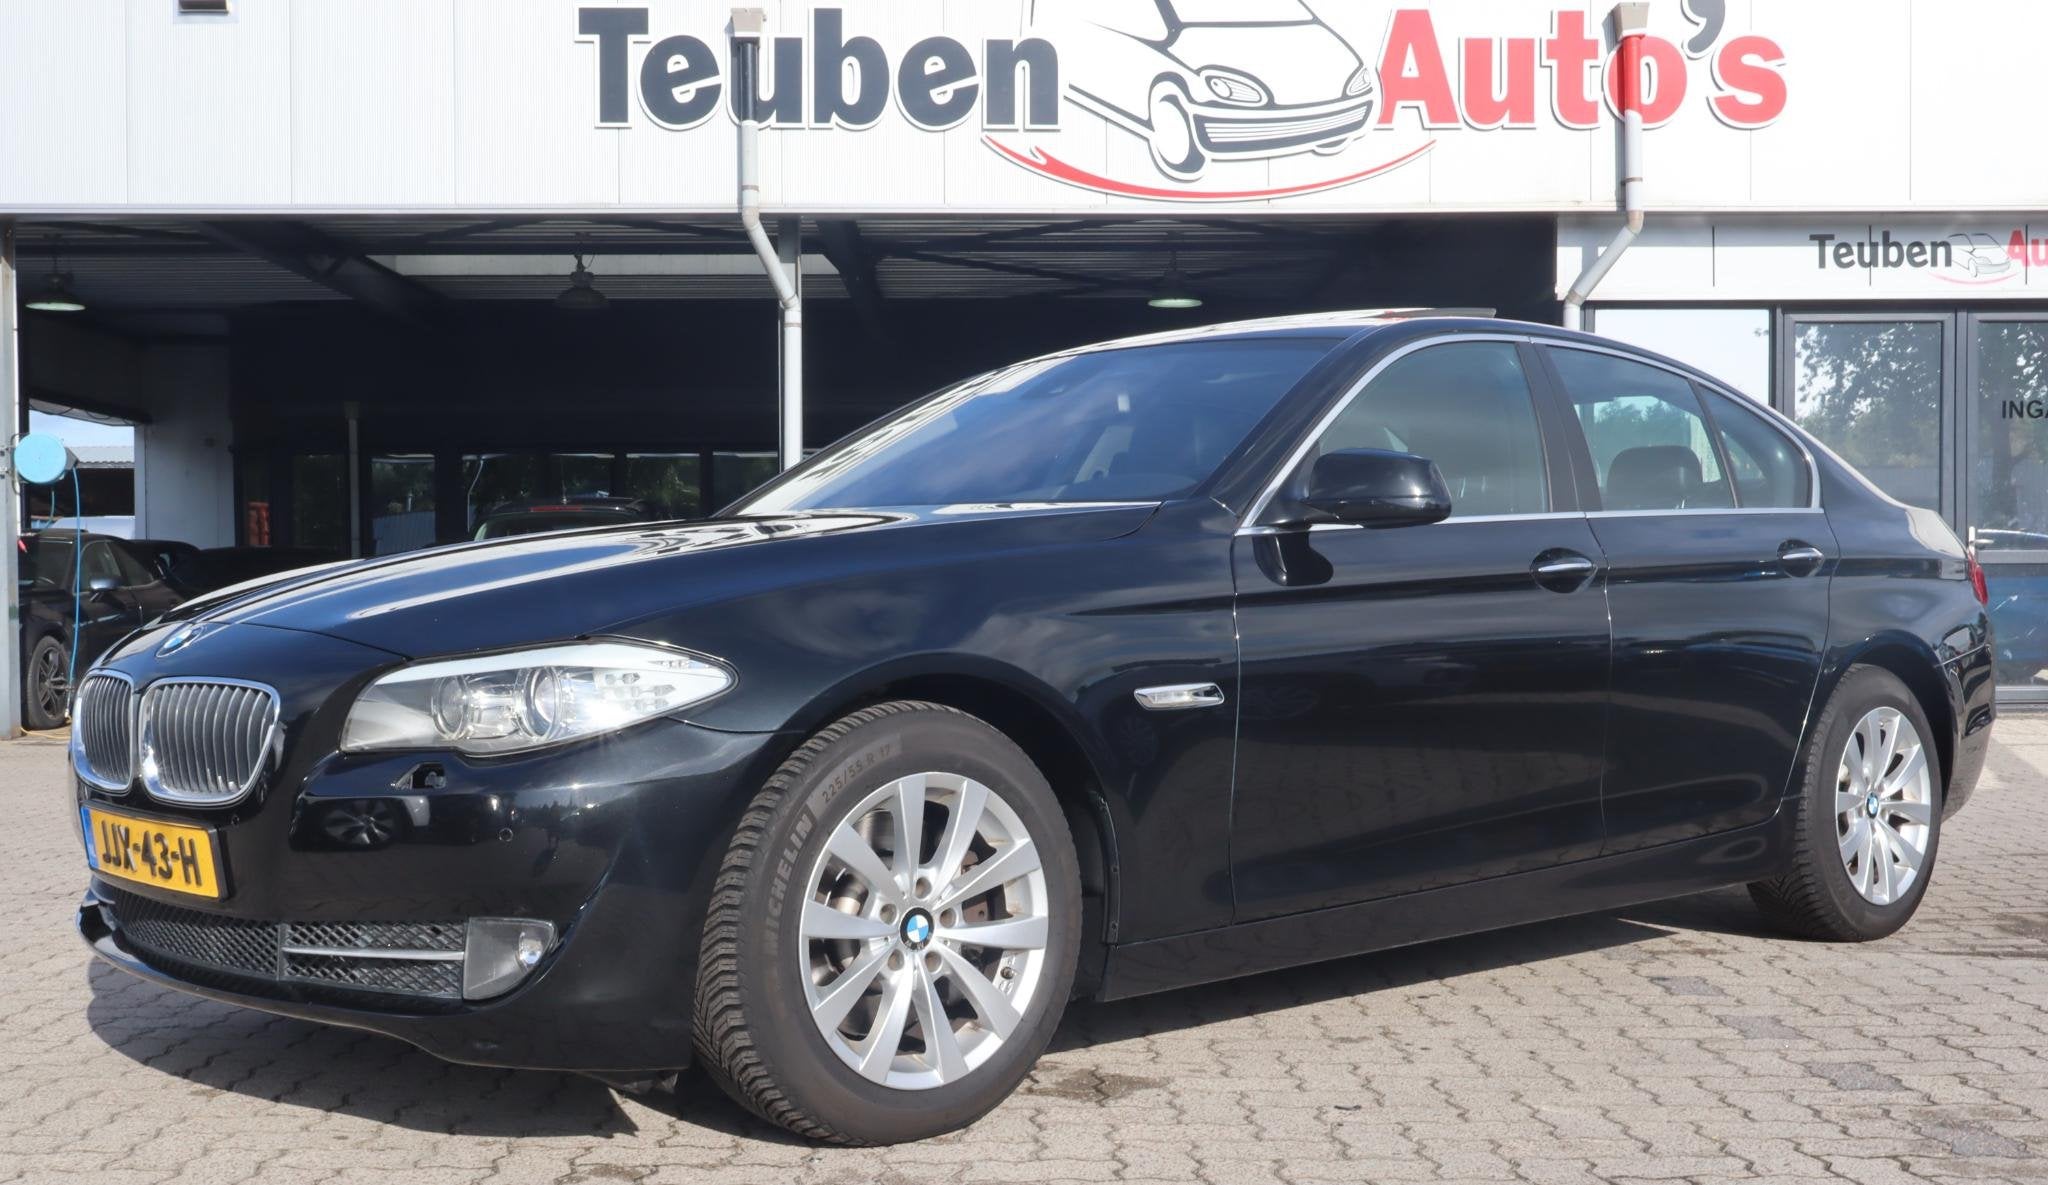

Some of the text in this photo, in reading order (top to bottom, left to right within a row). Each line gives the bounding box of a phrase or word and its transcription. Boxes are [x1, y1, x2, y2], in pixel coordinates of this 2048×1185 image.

[578, 0, 1788, 128] Teuben Auto's
[1809, 230, 1952, 269] Teuben
